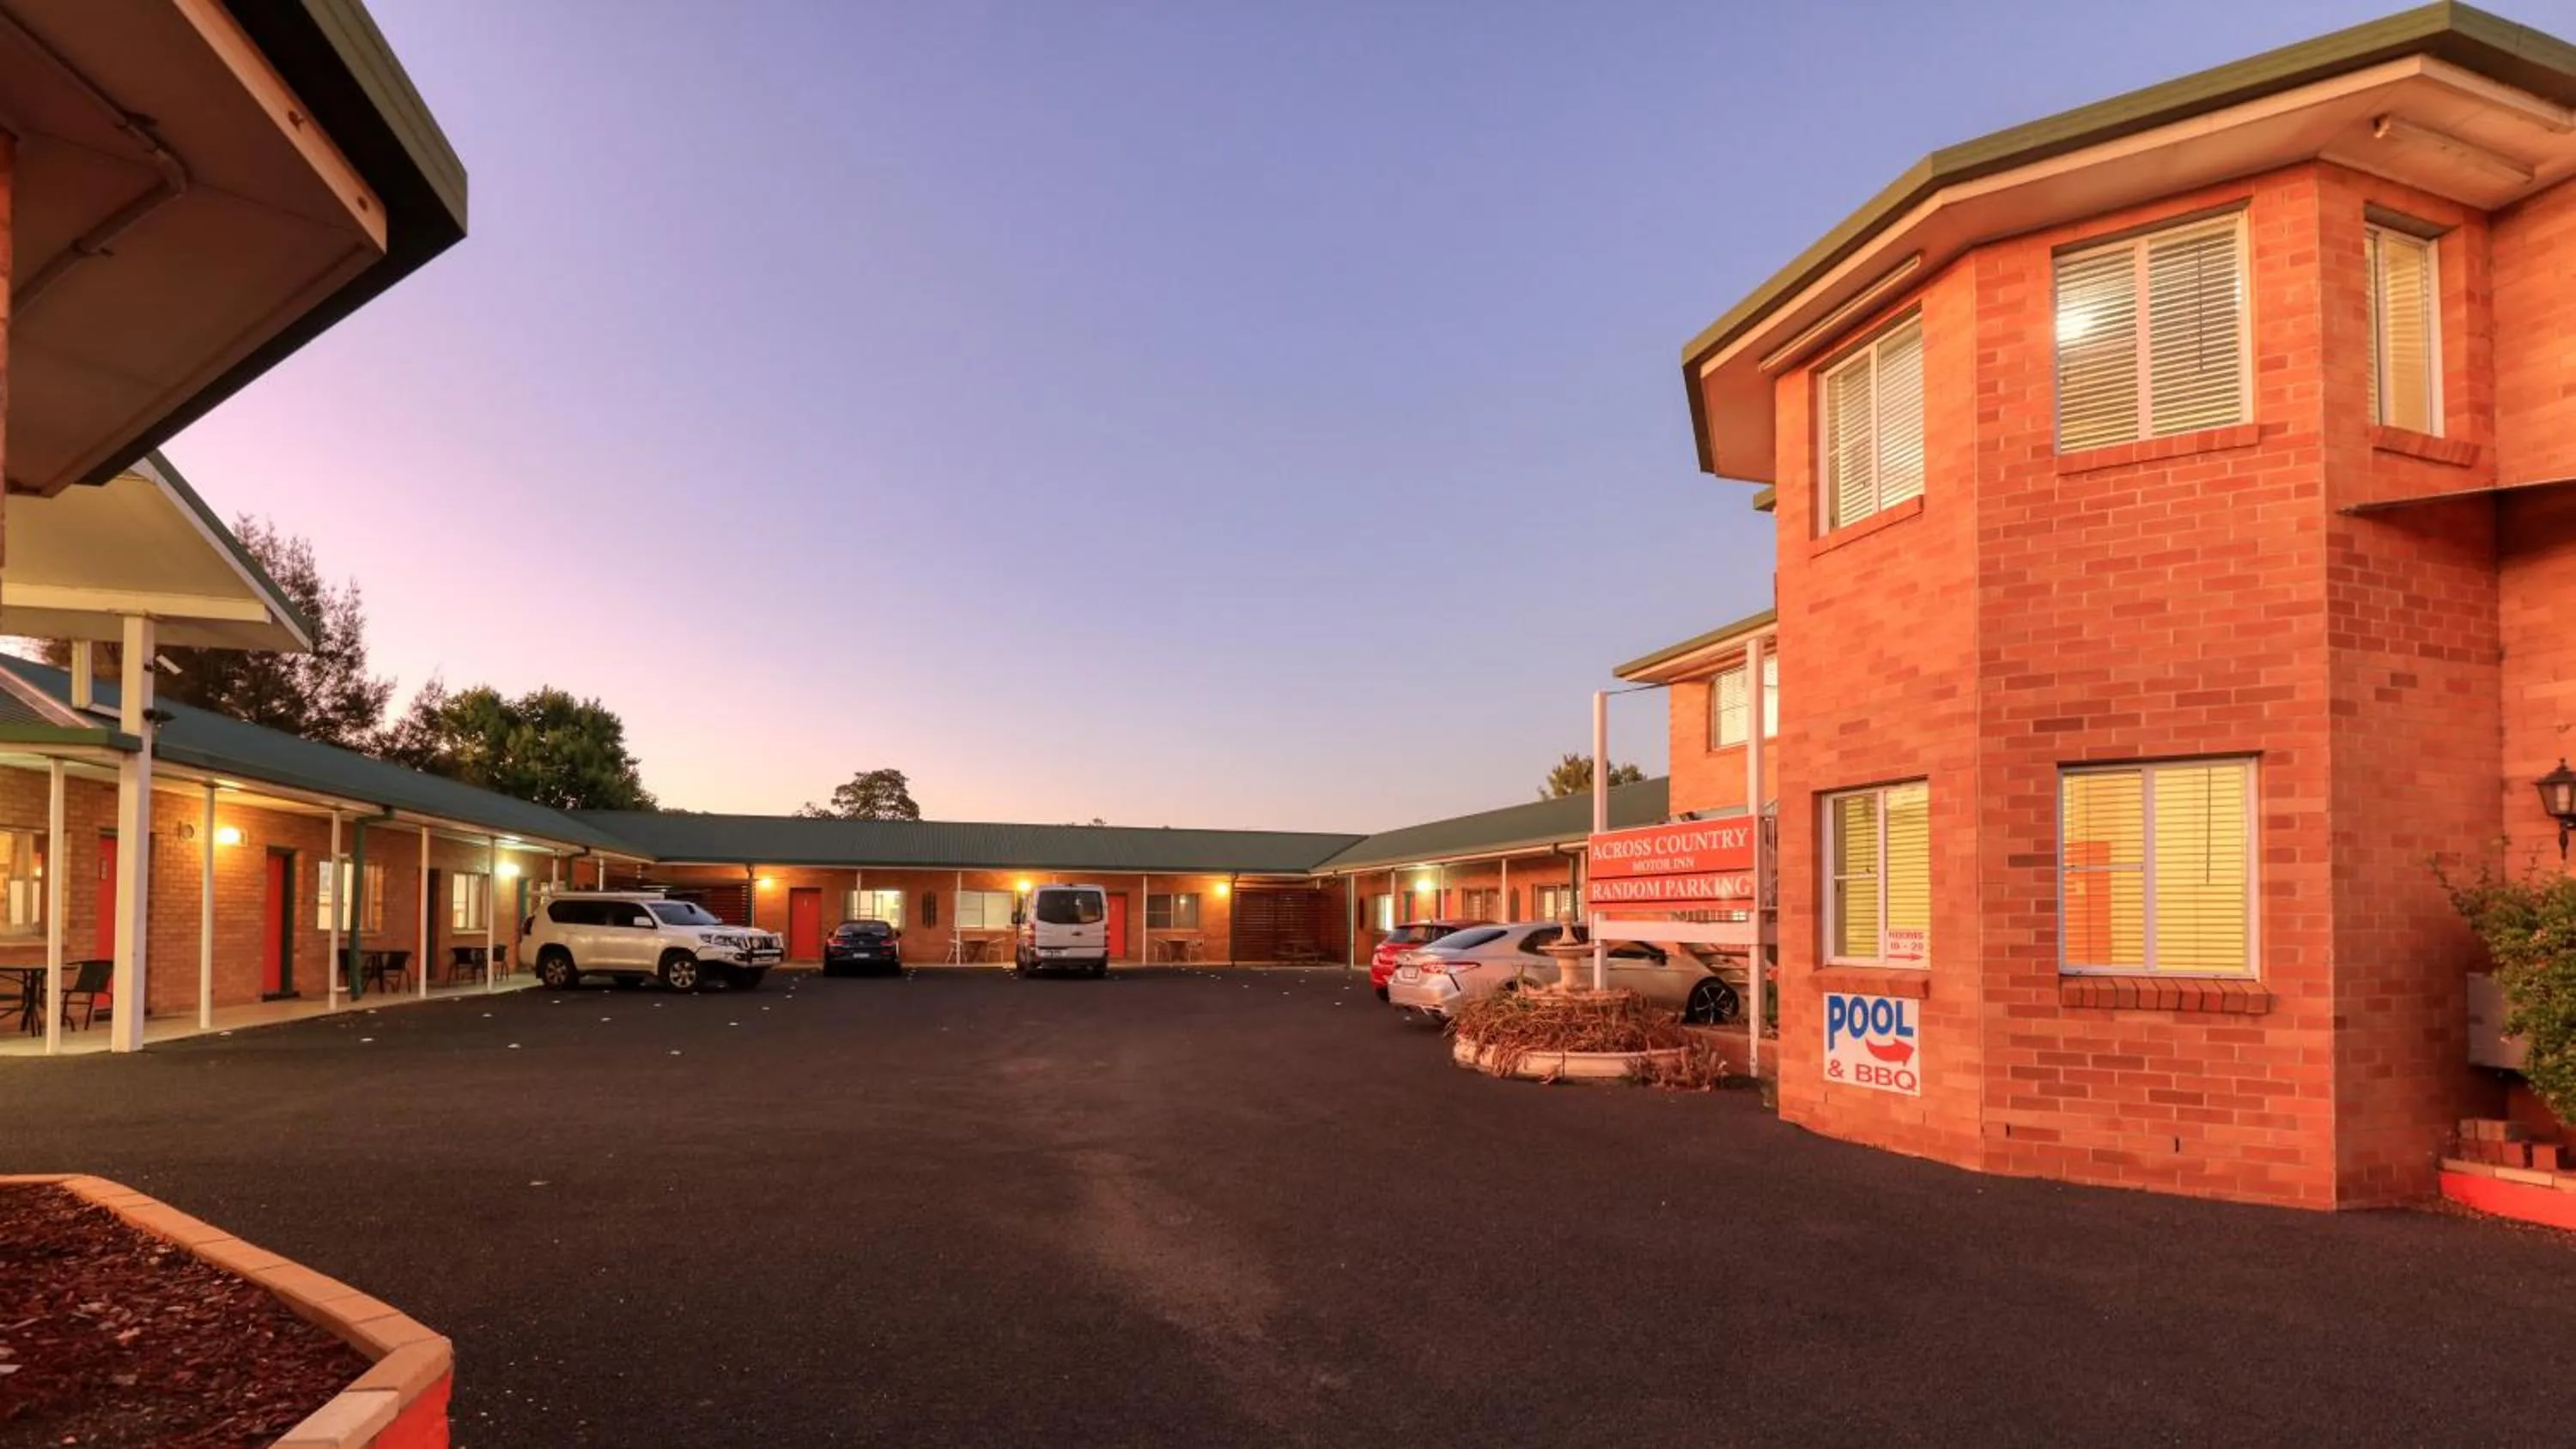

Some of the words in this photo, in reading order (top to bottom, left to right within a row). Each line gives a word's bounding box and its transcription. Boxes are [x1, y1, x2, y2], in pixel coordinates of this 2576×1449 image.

[1593, 840, 1651, 859] ACROSS
[1656, 828, 1747, 855] COUNTRY
[1633, 859, 1670, 872] MOTOR
[1674, 858, 1695, 869] INN
[1593, 881, 1660, 900] RANDOM
[1666, 876, 1751, 897] PARKING
[1828, 995, 1914, 1052] POOL
[1827, 1059, 1844, 1078] &
[1856, 1064, 1917, 1091] BBQ
